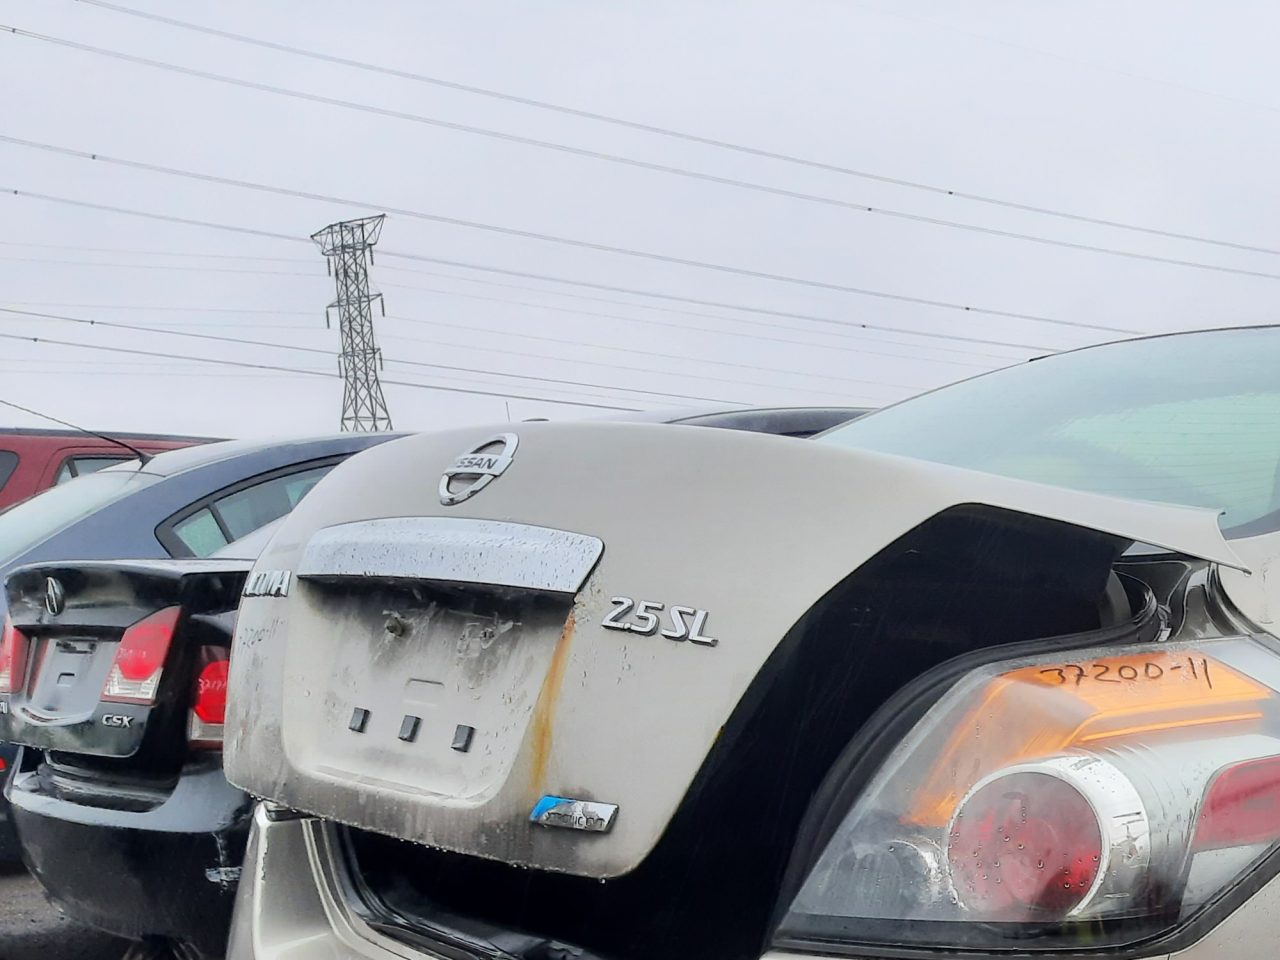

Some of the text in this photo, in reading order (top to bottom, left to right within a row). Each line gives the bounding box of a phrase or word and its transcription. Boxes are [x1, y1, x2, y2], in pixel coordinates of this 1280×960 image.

[454, 457, 498, 470] SSAN
[601, 596, 719, 647] 2.5 SL
[1039, 657, 1213, 690] 37200-11
[102, 714, 135, 728] CSX
